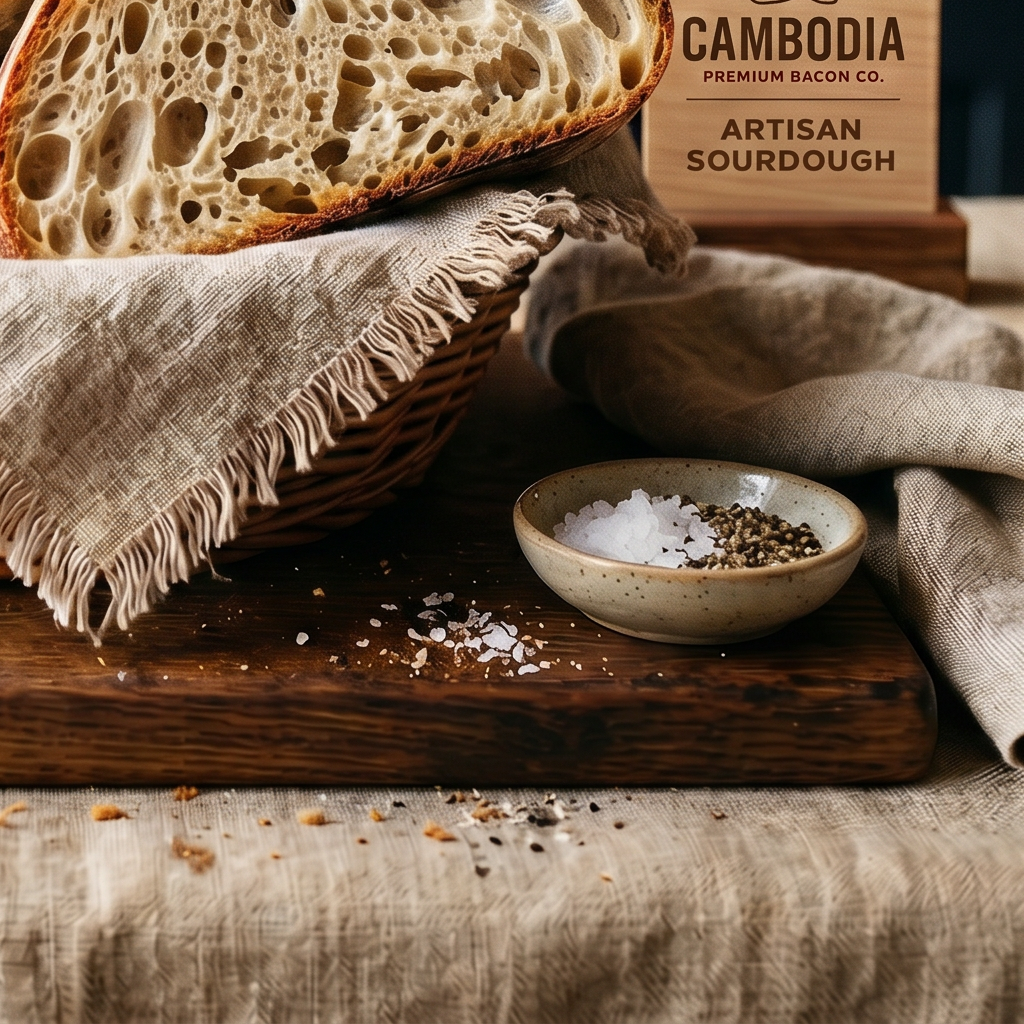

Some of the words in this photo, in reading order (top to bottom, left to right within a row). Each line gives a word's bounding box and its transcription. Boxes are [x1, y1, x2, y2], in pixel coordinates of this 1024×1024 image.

[682, 16, 905, 62] CAMBODIA
[703, 70, 784, 83] PREMIUM
[790, 70, 850, 83] BACON
[855, 70, 885, 83] CO.
[720, 118, 861, 141] ARTISAN
[686, 149, 895, 172] SOURDOUGH
